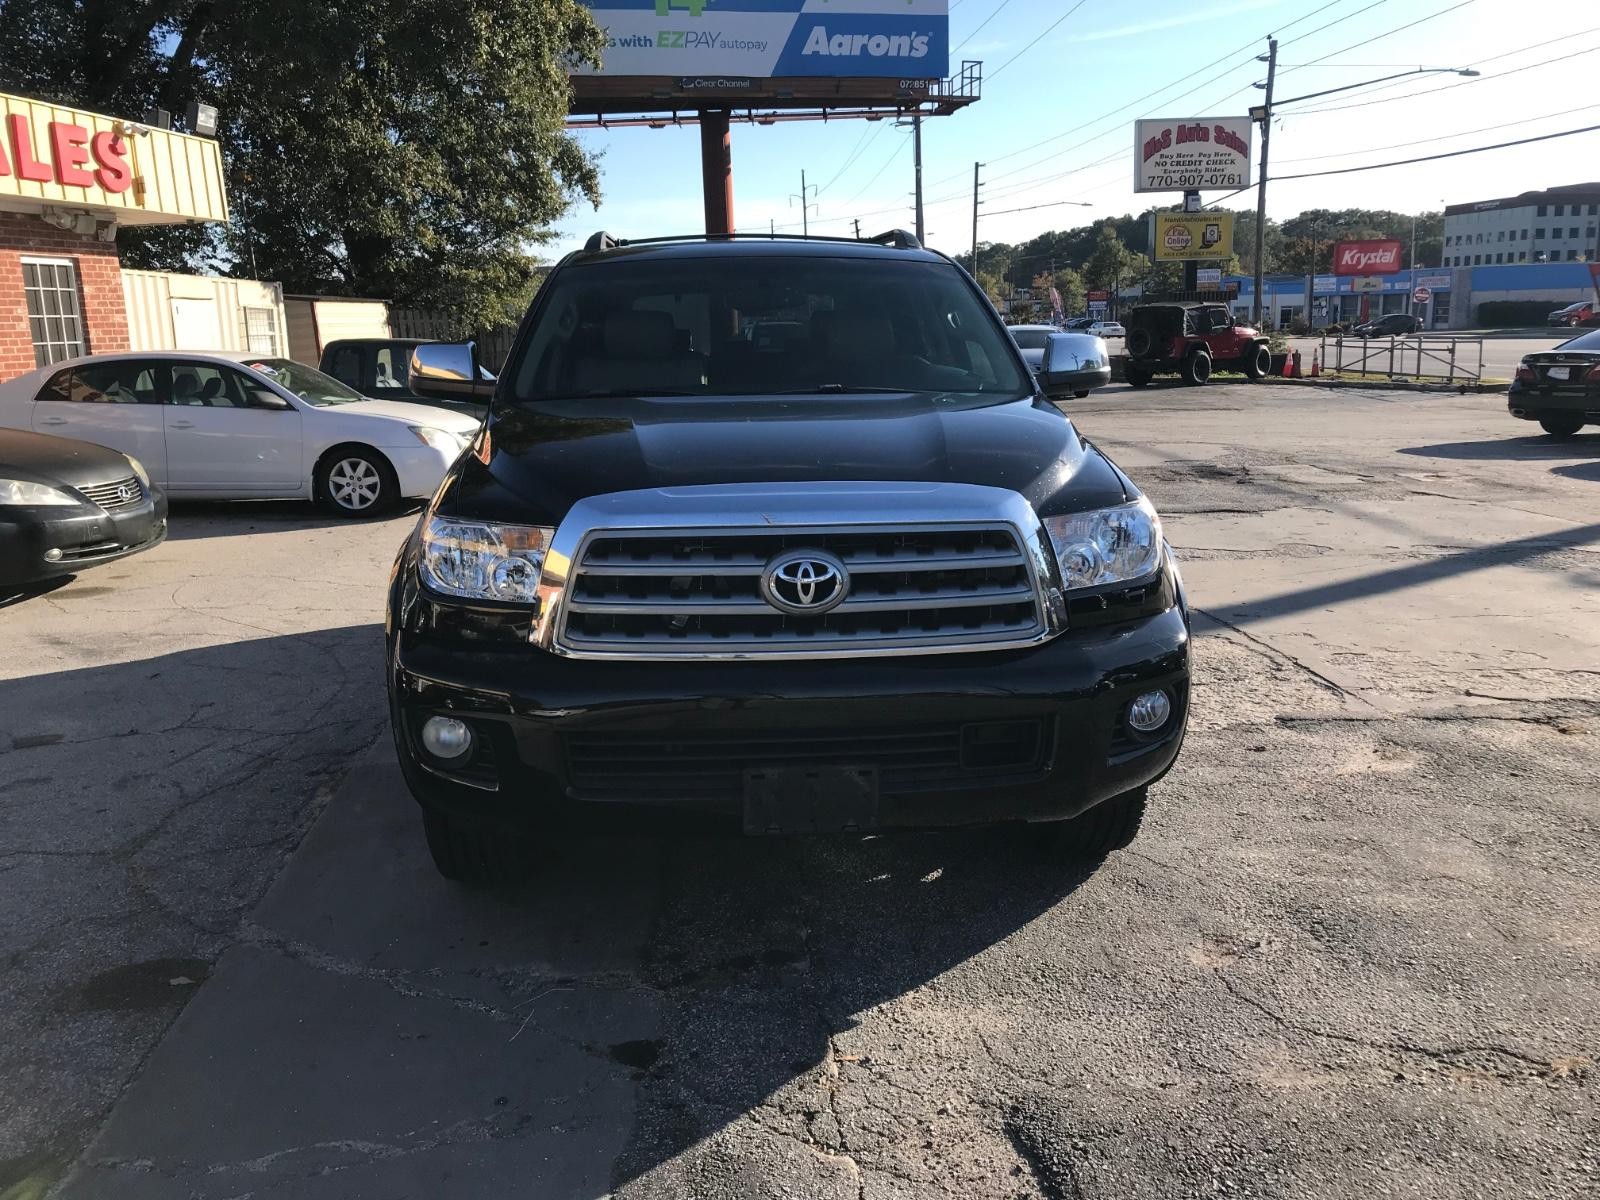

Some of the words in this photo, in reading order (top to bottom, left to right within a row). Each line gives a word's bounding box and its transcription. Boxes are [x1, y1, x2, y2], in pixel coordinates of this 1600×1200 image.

[618, 34, 653, 48] with
[656, 30, 722, 49] EZPAY
[719, 39, 768, 52] autopay
[801, 26, 929, 58] Aaron's
[694, 79, 716, 88] Clear
[717, 79, 750, 88] Channel
[899, 80, 929, 89] 072851
[1175, 123, 1210, 145] Auto
[1213, 124, 1249, 159] Sales
[0, 113, 132, 193] LES
[1169, 159, 1204, 167] CREDIT
[1206, 158, 1236, 166] CHECK
[1147, 173, 1242, 187] 770-907-0761
[1341, 247, 1398, 270] Krystal
